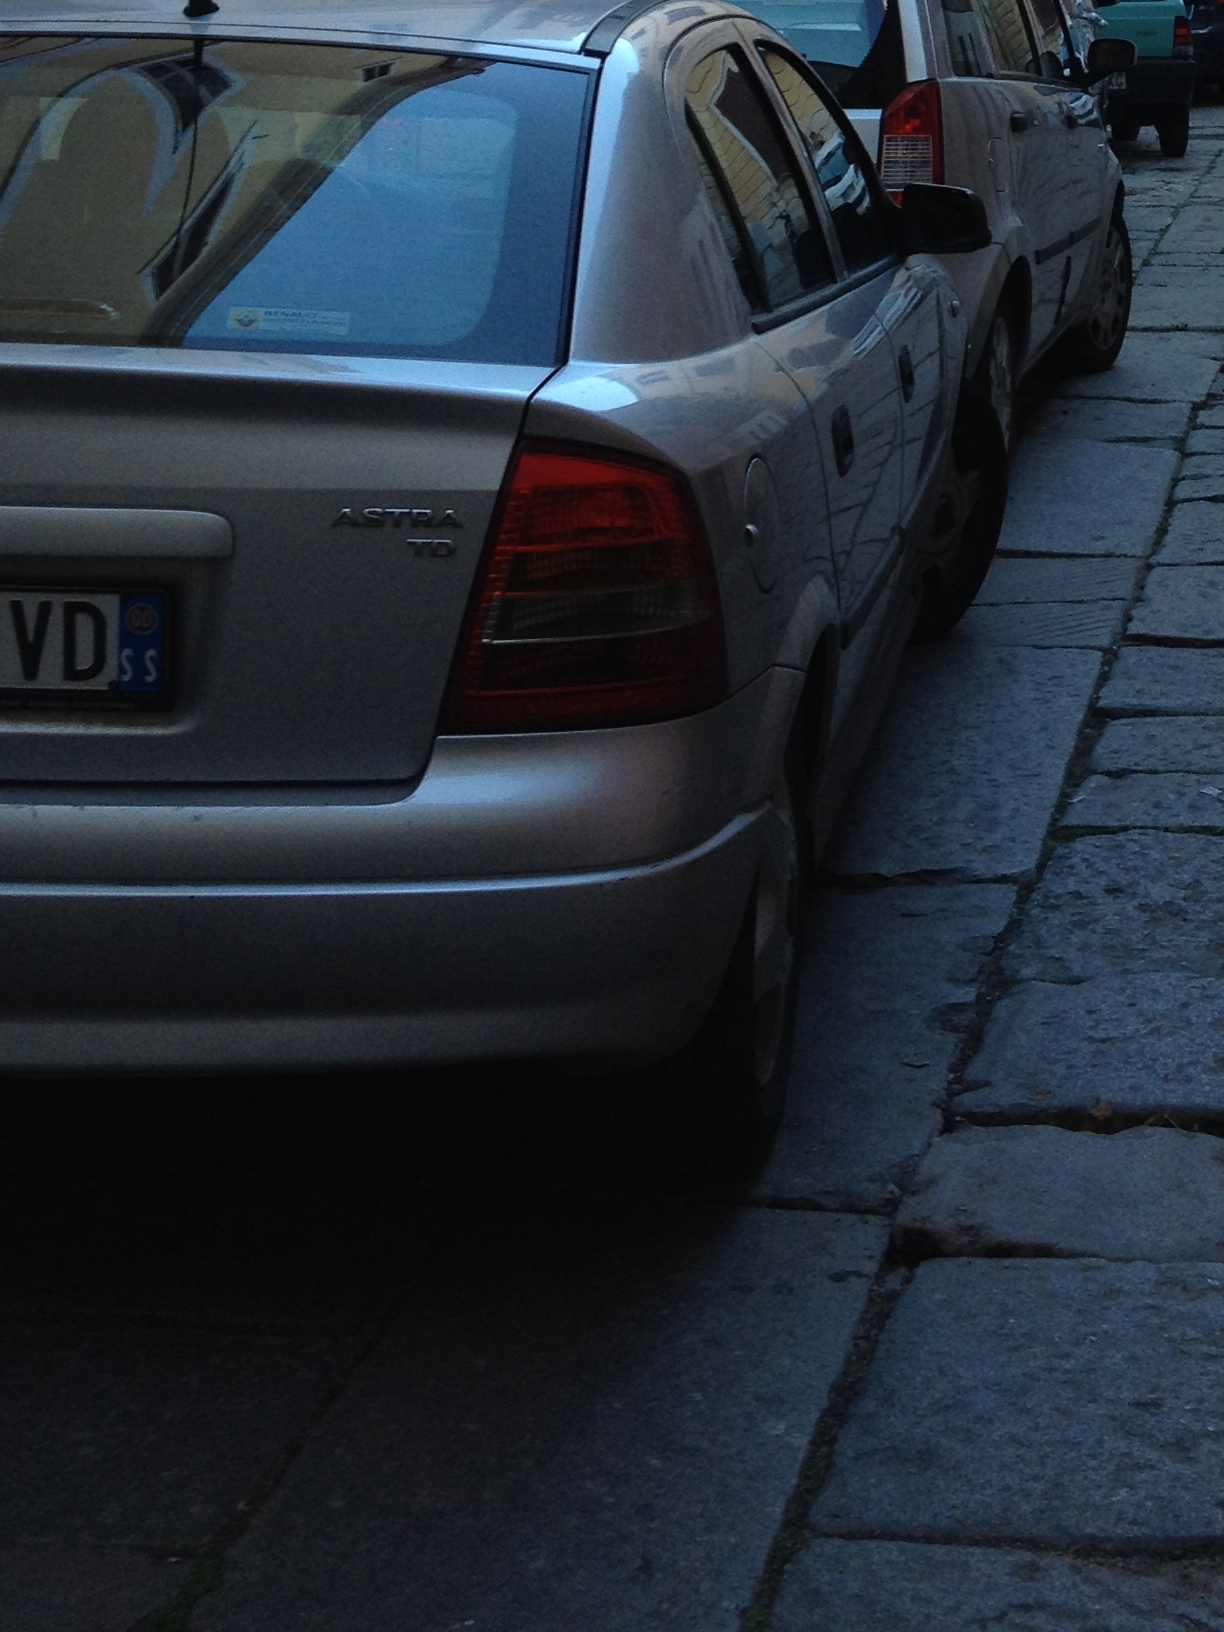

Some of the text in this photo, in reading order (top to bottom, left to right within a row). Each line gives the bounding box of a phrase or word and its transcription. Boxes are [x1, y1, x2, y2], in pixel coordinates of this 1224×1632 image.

[331, 506, 464, 529] ASTRA
[8, 599, 107, 681] VD
[120, 647, 158, 683] SS
